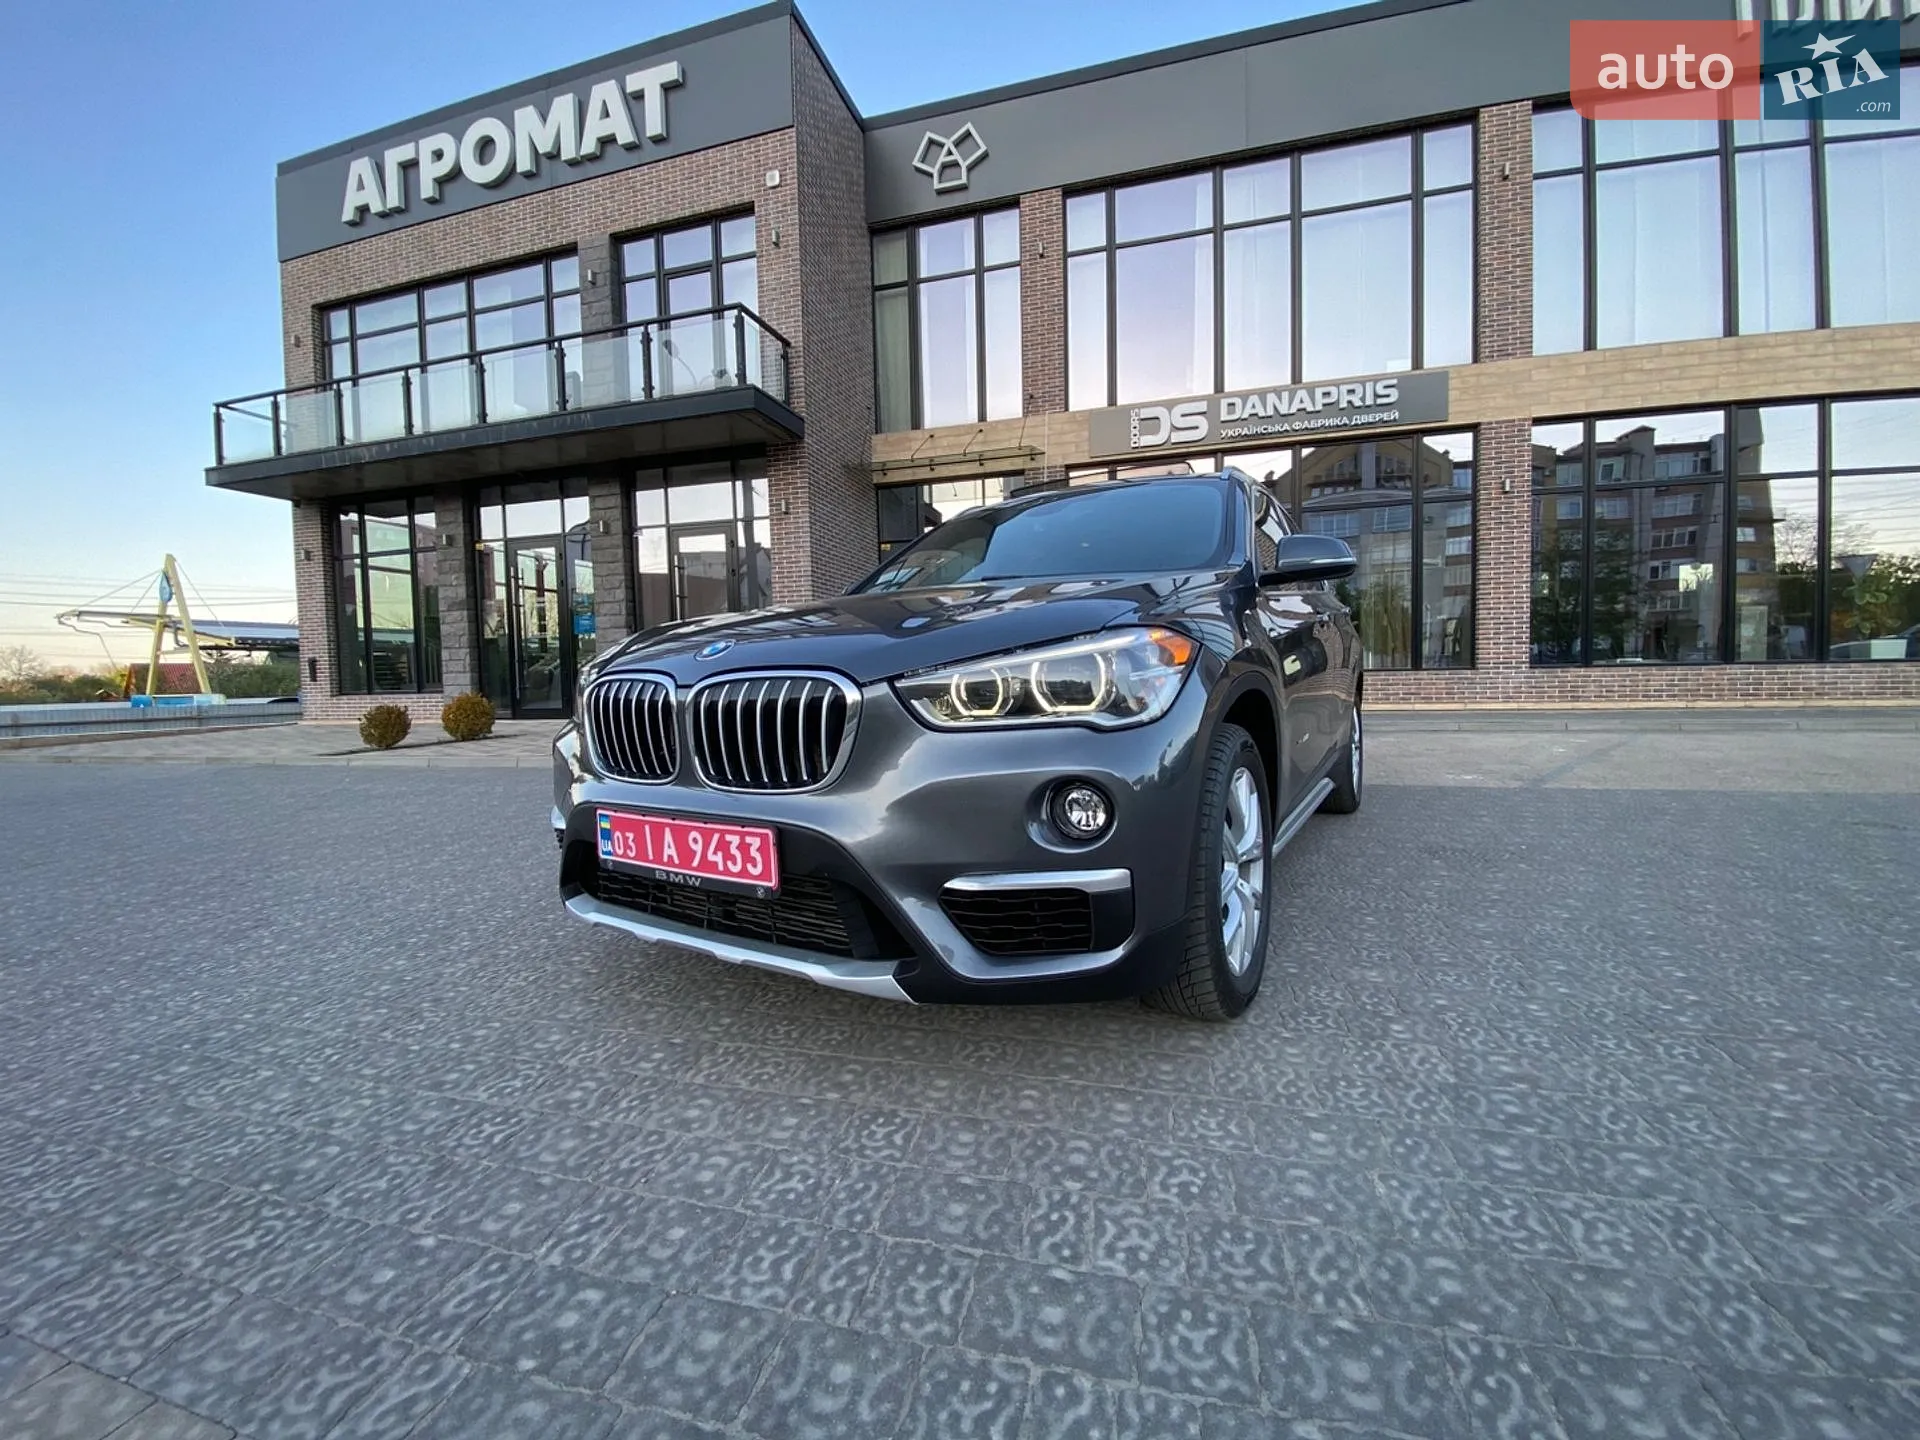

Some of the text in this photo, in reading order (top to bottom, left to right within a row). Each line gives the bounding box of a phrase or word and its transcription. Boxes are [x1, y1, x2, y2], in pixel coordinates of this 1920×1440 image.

[341, 60, 684, 226] АГРОМАТ
[1220, 378, 1399, 423] DANAPRIS
[1130, 408, 1140, 448] DOORS
[1140, 400, 1209, 447] DS
[1220, 409, 1400, 440] УКРАЇНСЬКА ФАБРИКА ДВЕРЕЙ
[601, 838, 614, 853] UA
[614, 824, 764, 876] 03 IA 9433
[655, 869, 702, 888] BMW
